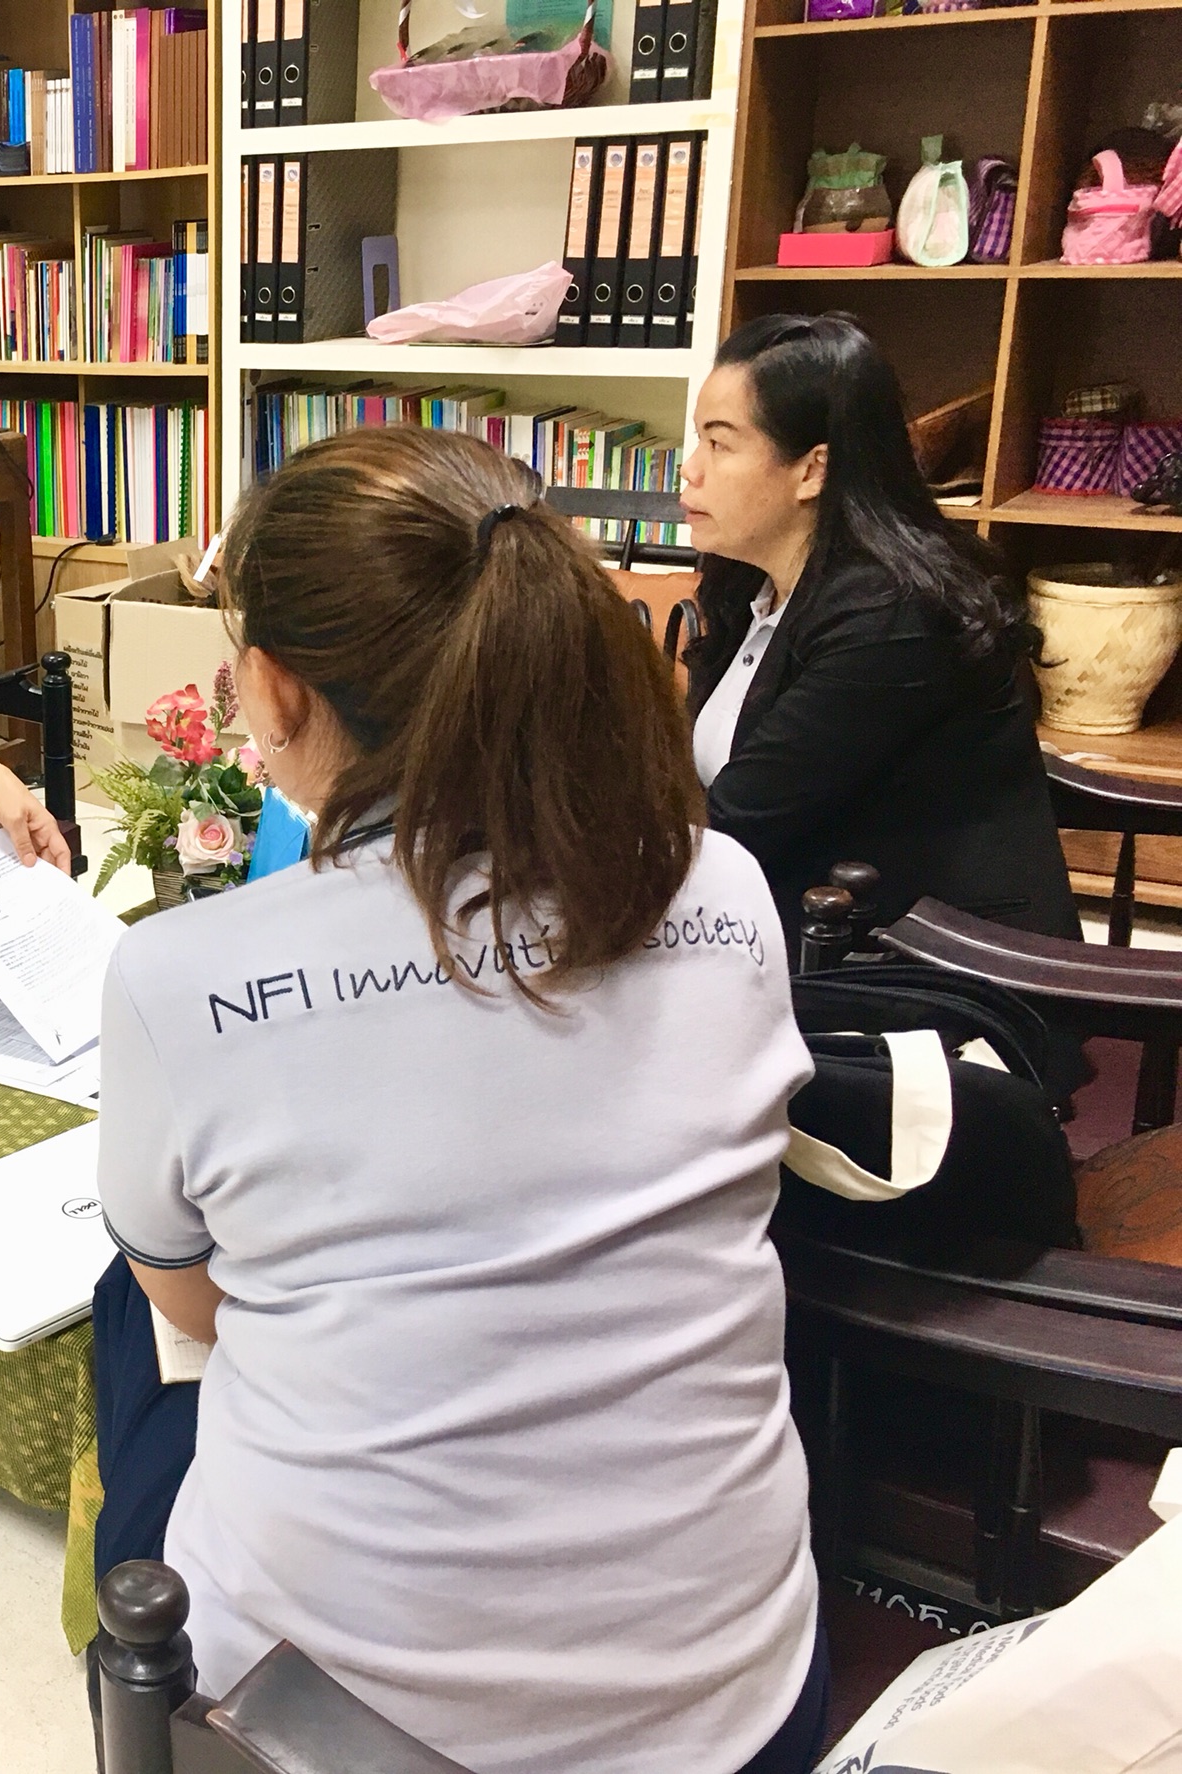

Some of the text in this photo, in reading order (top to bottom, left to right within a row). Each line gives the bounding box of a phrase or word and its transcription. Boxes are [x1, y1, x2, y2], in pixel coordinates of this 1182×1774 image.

[208, 968, 313, 1034] NFI
[333, 924, 558, 1002] Innovati
[68, 1201, 98, 1215] DELL
